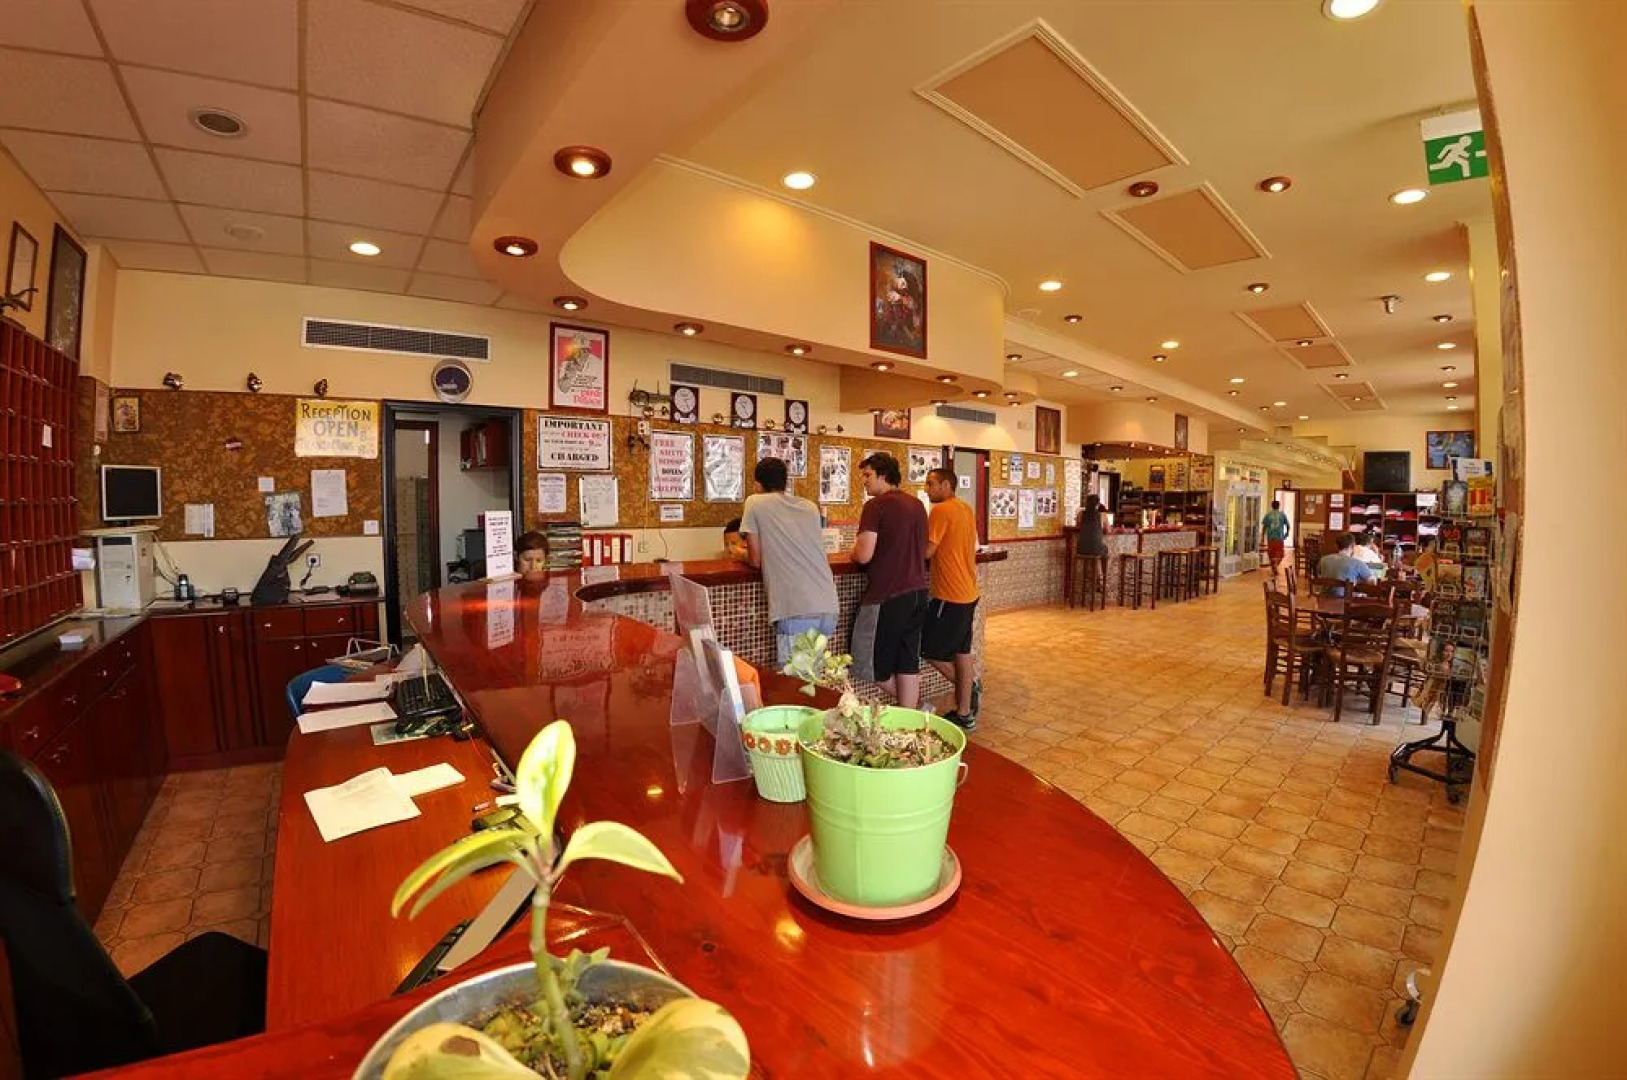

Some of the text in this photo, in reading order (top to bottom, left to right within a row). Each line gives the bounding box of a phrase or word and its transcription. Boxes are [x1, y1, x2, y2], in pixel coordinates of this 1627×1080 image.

[301, 403, 371, 421] RECEPTION
[313, 420, 359, 437] OPEN
[544, 420, 603, 431] IMPORTANT
[551, 452, 599, 461] CHARGED
